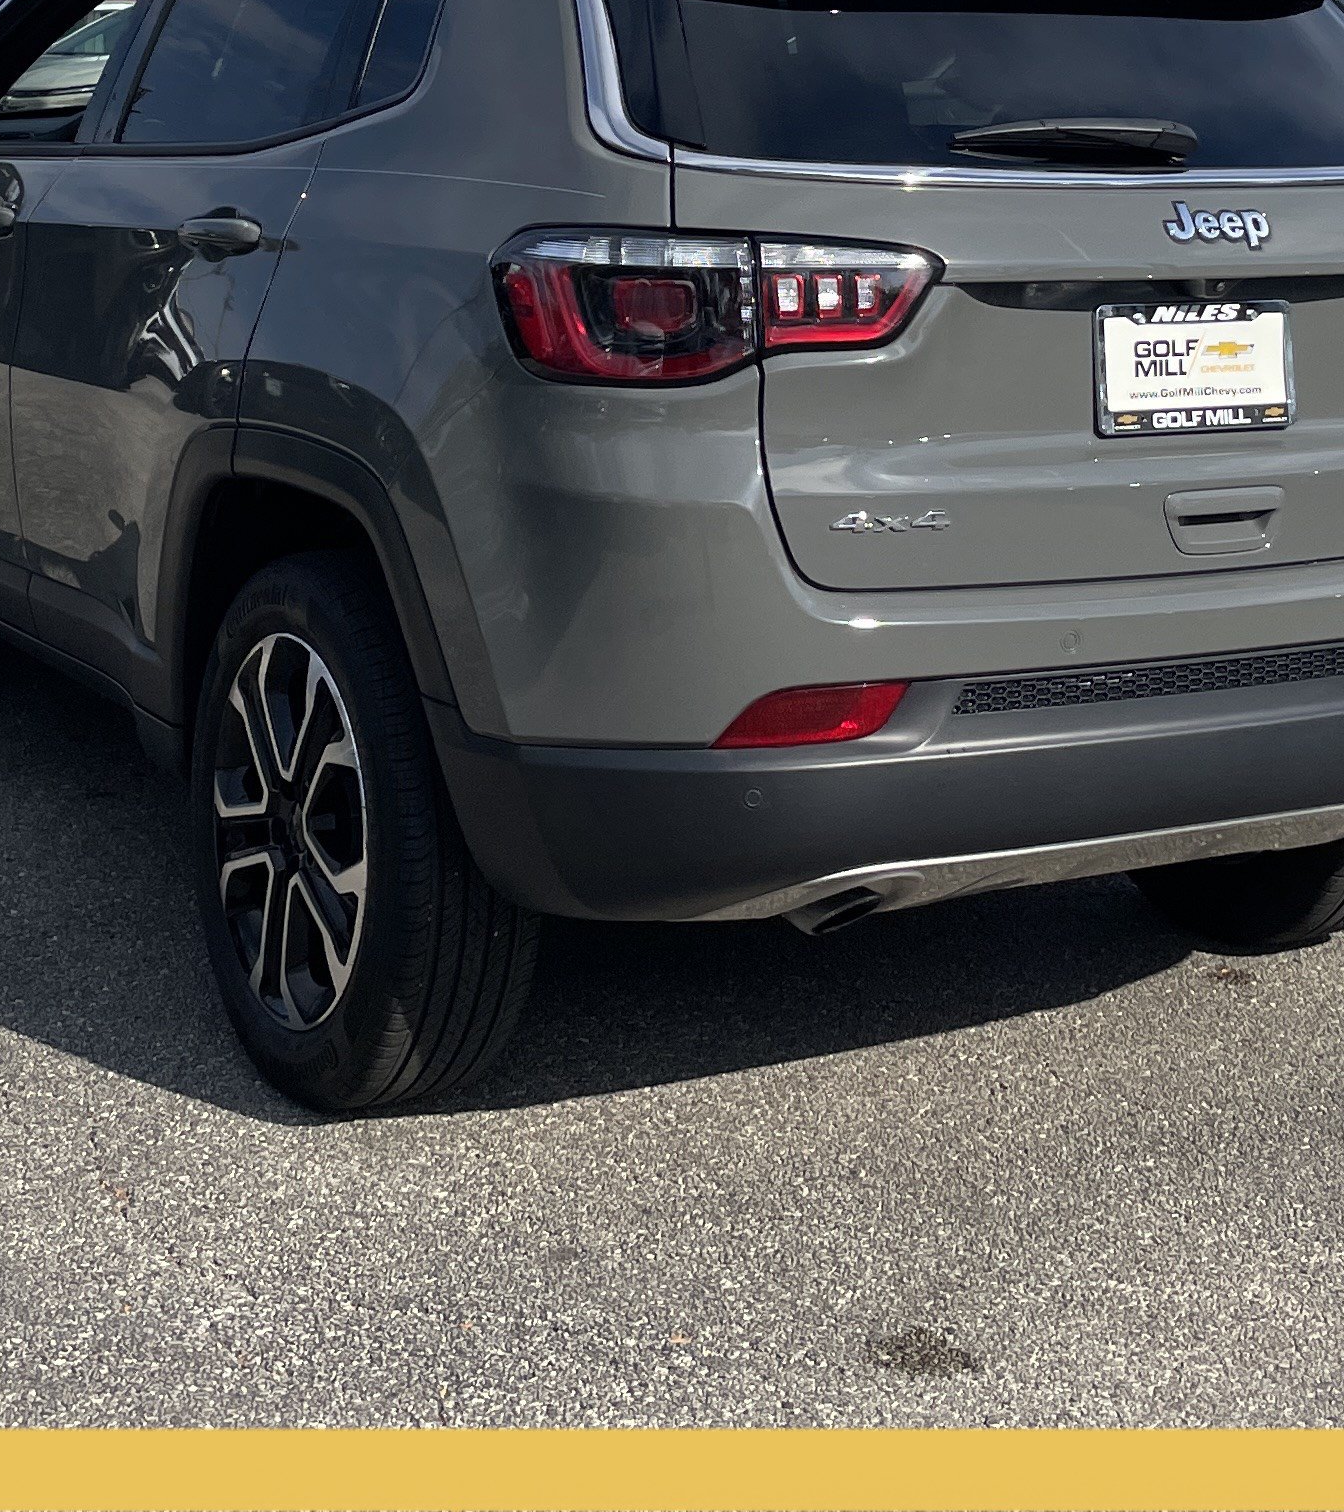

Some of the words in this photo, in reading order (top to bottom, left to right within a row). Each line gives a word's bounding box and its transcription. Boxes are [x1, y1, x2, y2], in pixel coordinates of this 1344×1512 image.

[1163, 200, 1271, 251] Jeep
[1151, 303, 1241, 323] NILES
[1134, 338, 1199, 358] GOLF
[1134, 358, 1188, 378] MILL
[1201, 363, 1256, 374] CHEVROLET
[1129, 386, 1262, 400] www.GolfMillChevy.com
[1152, 410, 1204, 429] GOLF
[1205, 407, 1252, 426] MILL
